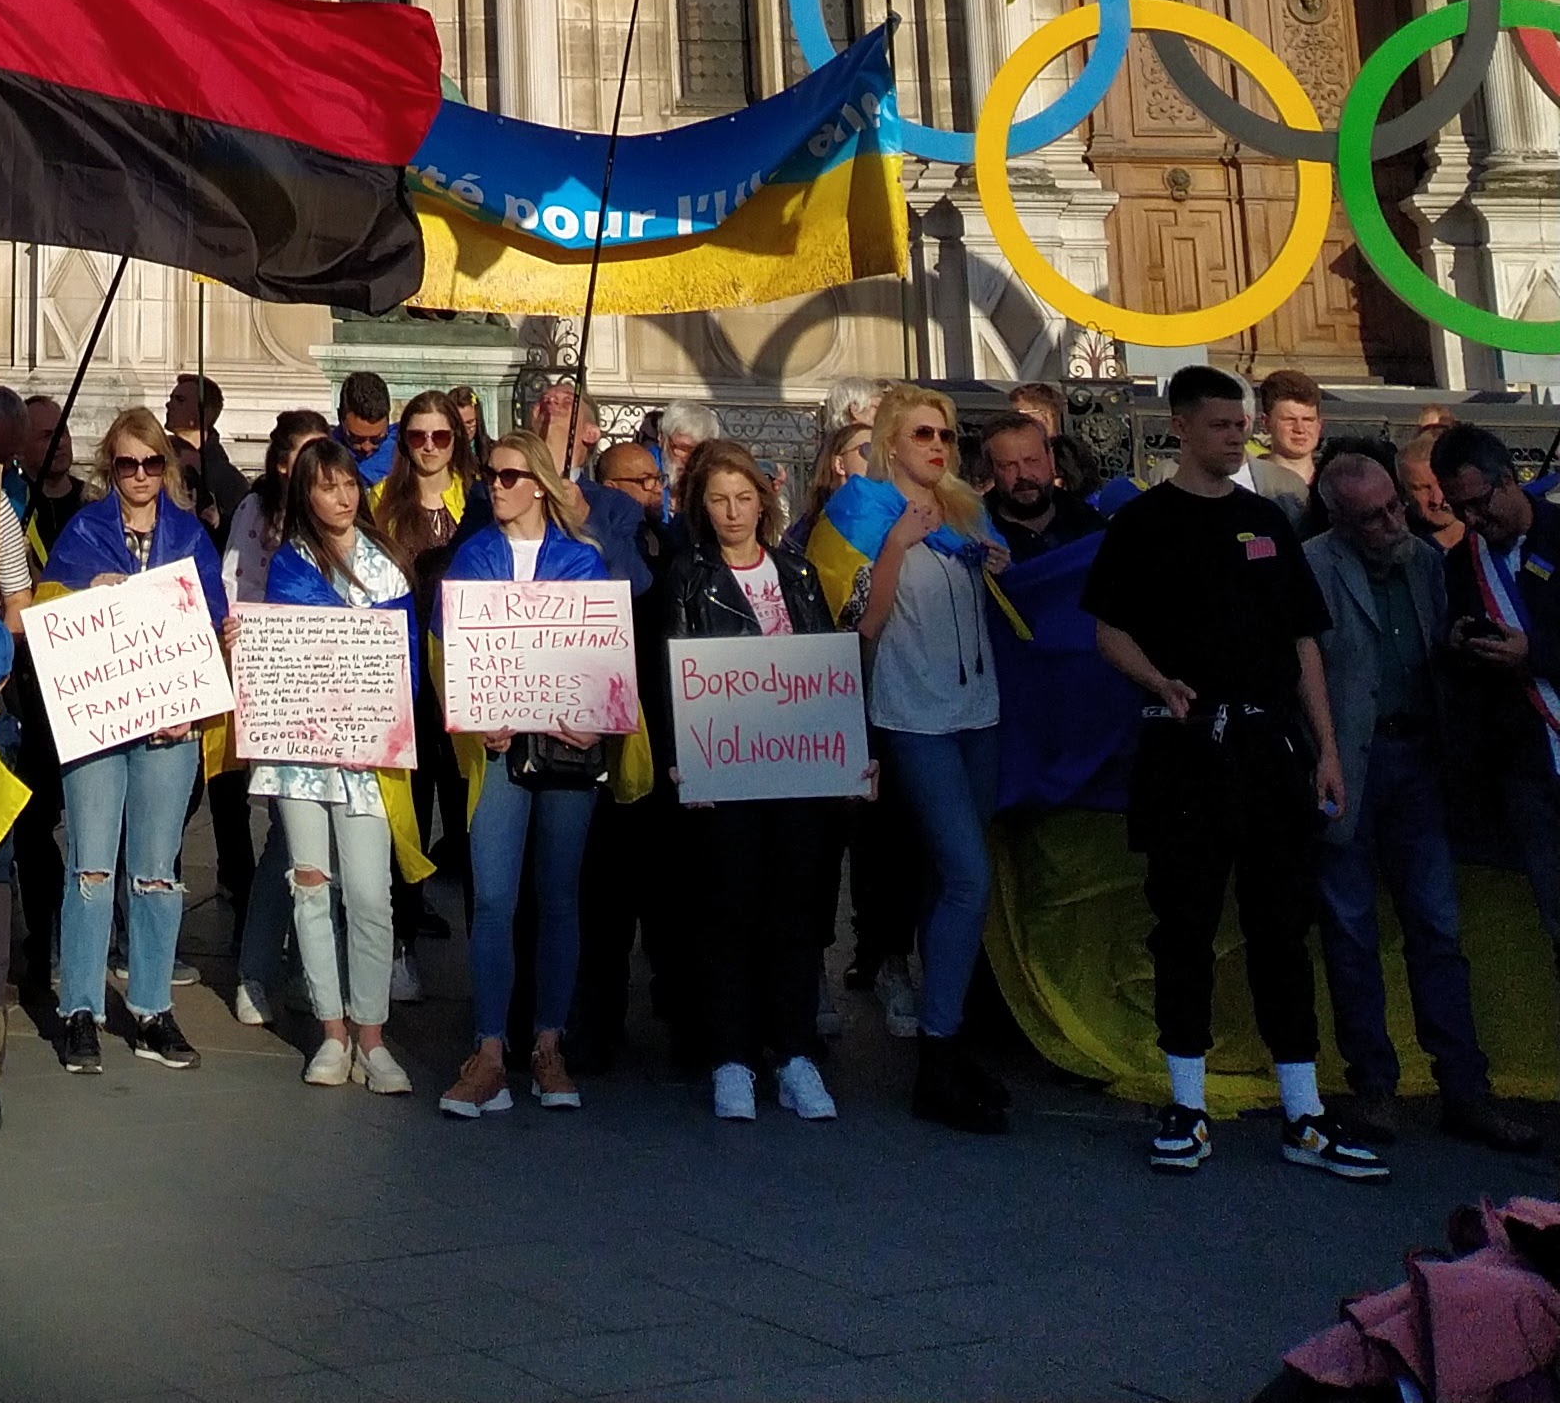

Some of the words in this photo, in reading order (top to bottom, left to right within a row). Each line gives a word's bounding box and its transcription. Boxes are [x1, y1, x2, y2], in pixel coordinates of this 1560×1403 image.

[502, 192, 657, 240] pour
[458, 589, 492, 621] LA
[466, 674, 583, 691] TORTURES
[470, 691, 582, 707] MEURTRES
[335, 723, 366, 732] STOP
[249, 730, 316, 743] GENOCIDE
[690, 717, 846, 770] VOLNOVAHA
[287, 742, 345, 758] UKRAINE
